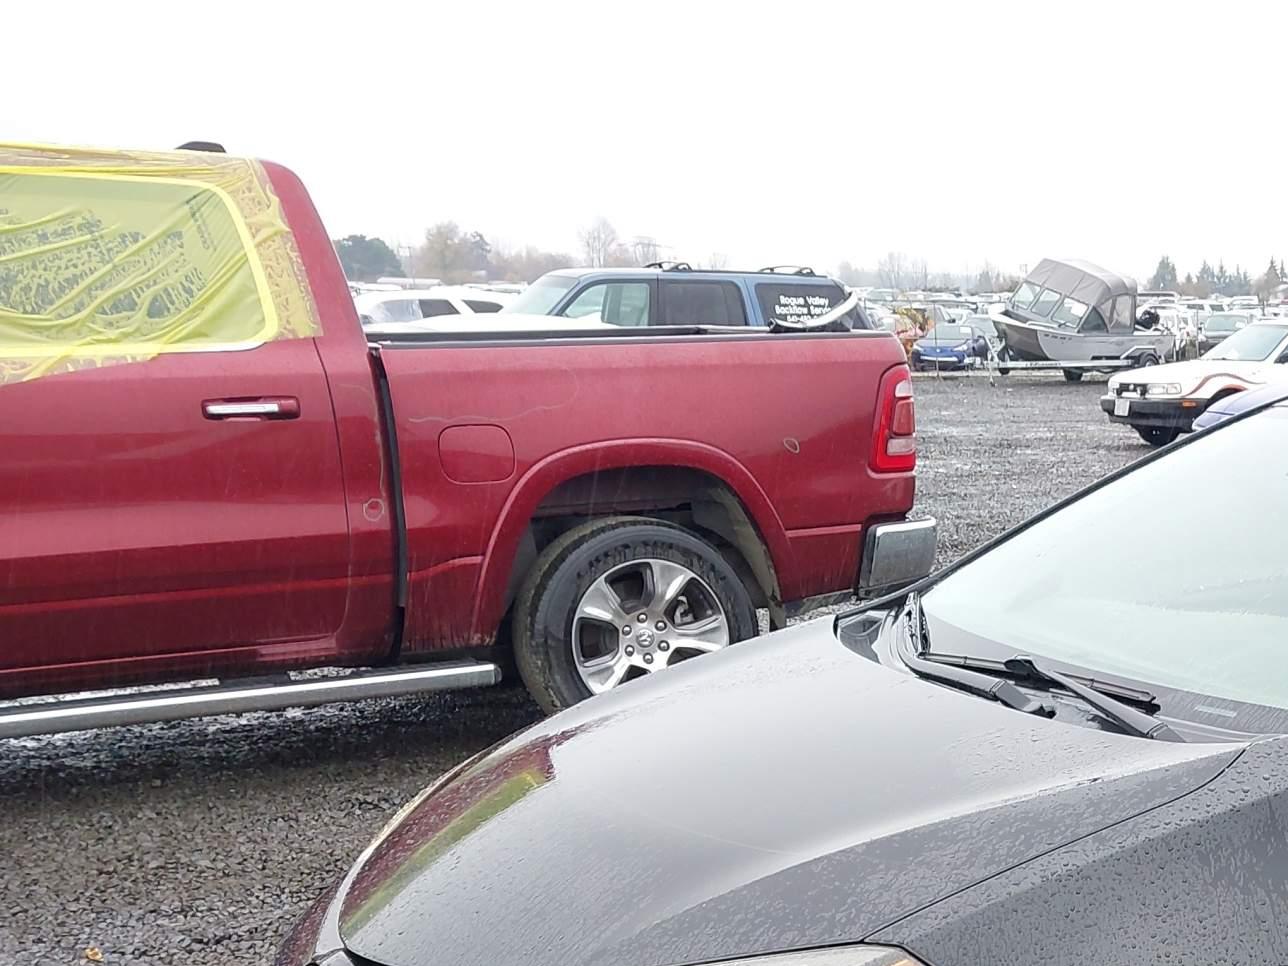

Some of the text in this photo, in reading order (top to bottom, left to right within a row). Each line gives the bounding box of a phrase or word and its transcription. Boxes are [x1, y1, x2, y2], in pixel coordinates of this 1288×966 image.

[779, 295, 829, 307] Rogue Valley
[775, 305, 808, 315] Backflow
